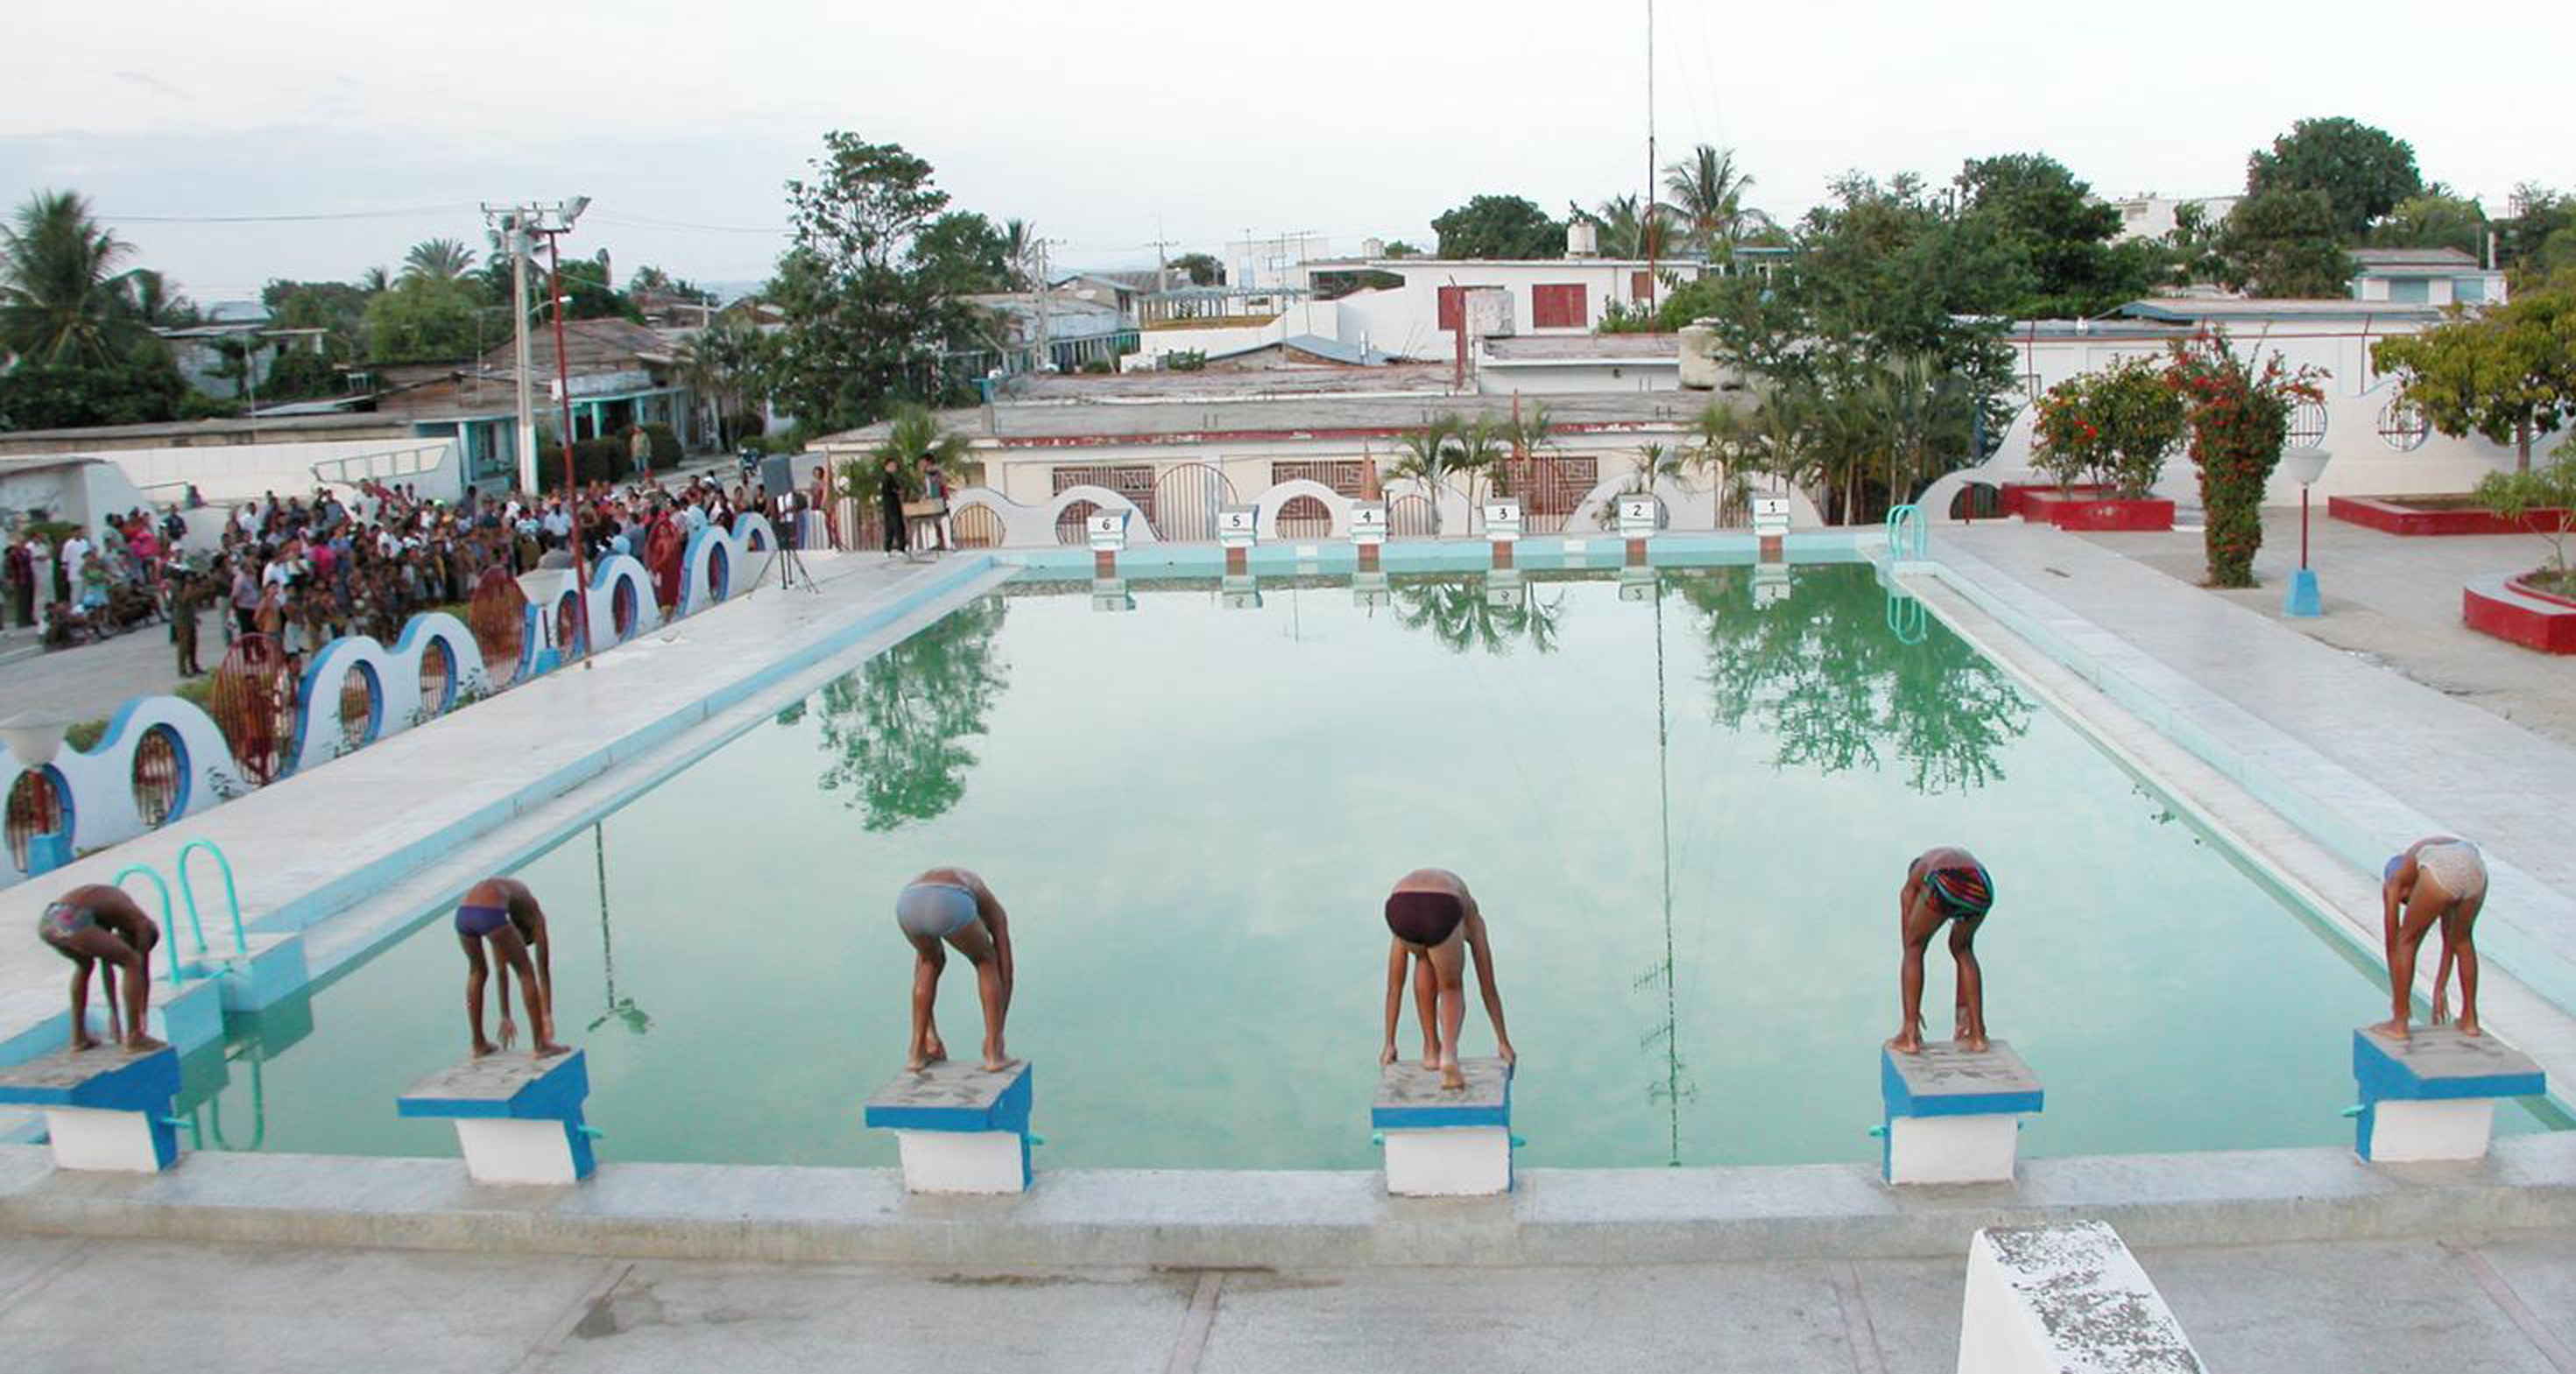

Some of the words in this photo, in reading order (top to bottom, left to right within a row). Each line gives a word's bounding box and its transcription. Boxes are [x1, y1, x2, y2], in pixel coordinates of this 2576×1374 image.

[1633, 504, 1642, 517] 2
[1769, 502, 1776, 513] 1
[1363, 511, 1372, 523] 4
[1500, 508, 1508, 520] 3
[1102, 519, 1111, 531] 6
[1232, 515, 1241, 527] 5
